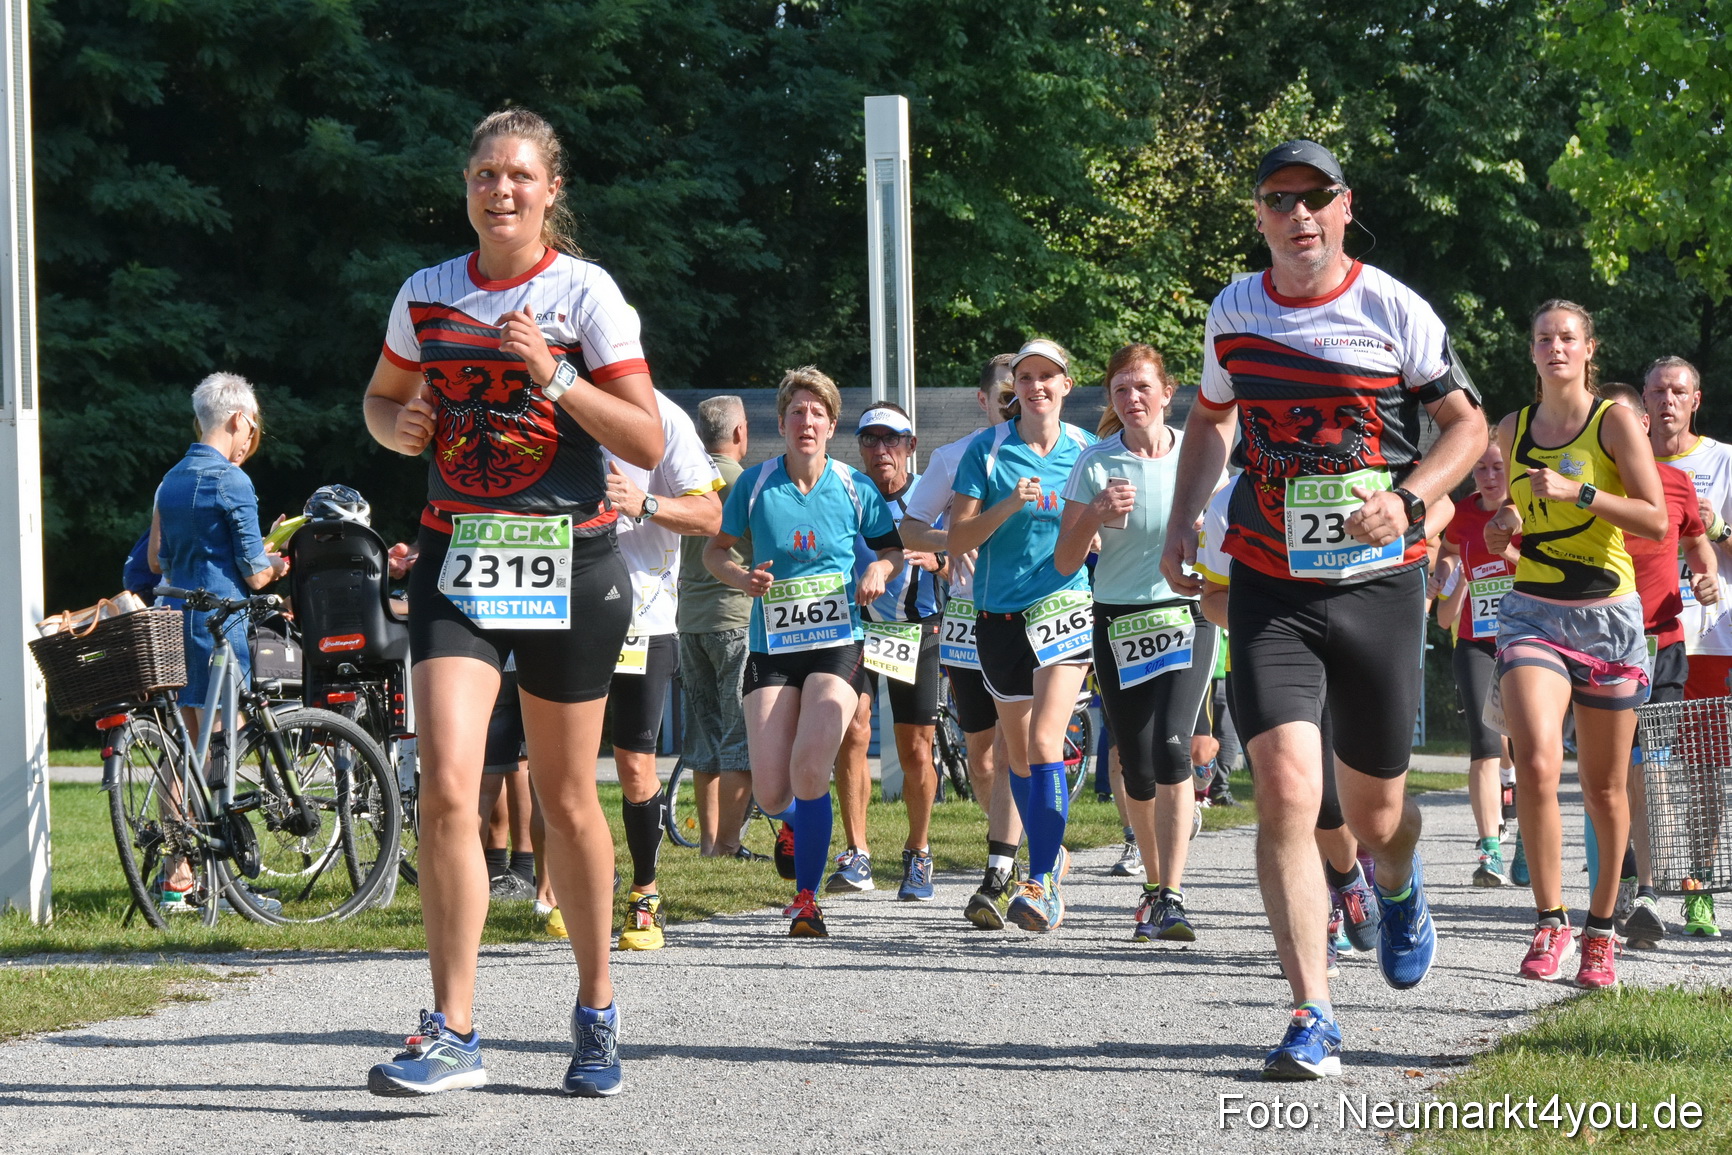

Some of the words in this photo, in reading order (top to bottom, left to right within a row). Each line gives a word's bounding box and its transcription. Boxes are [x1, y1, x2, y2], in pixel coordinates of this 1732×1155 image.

[1294, 476, 1384, 504] BOCK
[457, 519, 561, 545] BOCK
[1300, 512, 1346, 544] 23
[1313, 548, 1383, 567] JÜRGEN
[453, 554, 555, 588] 2319
[1481, 565, 1497, 573] DEHN
[604, 593, 621, 601] adidas
[769, 577, 840, 601] BOCK
[1473, 580, 1514, 595] BOC
[452, 600, 557, 615] CHRISTINA
[774, 600, 840, 628] 2462
[1479, 598, 1500, 616] 25
[945, 621, 976, 645] 225
[1114, 611, 1187, 637] BOCK
[1487, 621, 1500, 630] SA
[322, 638, 362, 650] Polisport
[781, 629, 838, 645] MELANIE
[868, 637, 911, 662] 328
[1144, 658, 1166, 675] RITA
[1053, 773, 1063, 794] pressure
